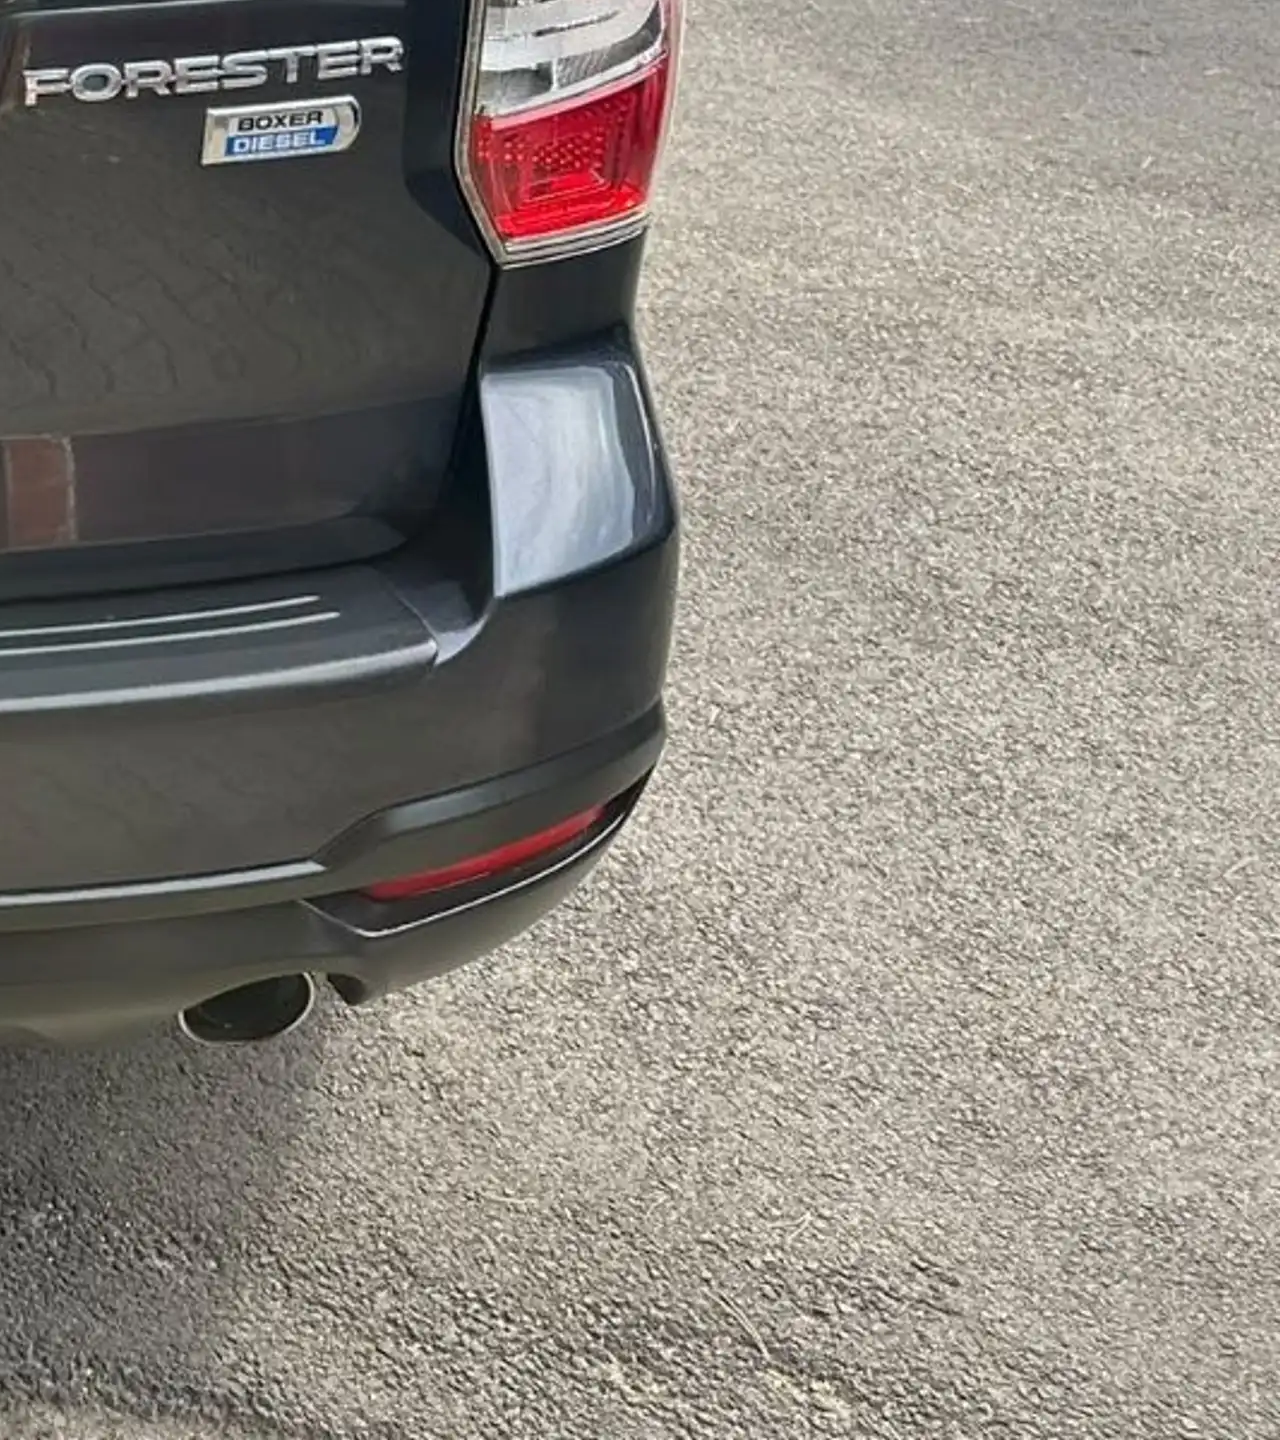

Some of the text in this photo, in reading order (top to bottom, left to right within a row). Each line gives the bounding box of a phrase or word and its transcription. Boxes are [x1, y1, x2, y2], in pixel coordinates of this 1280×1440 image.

[22, 36, 404, 107] FORESTER
[237, 109, 324, 132] BOXER
[232, 129, 327, 154] DIESEL
